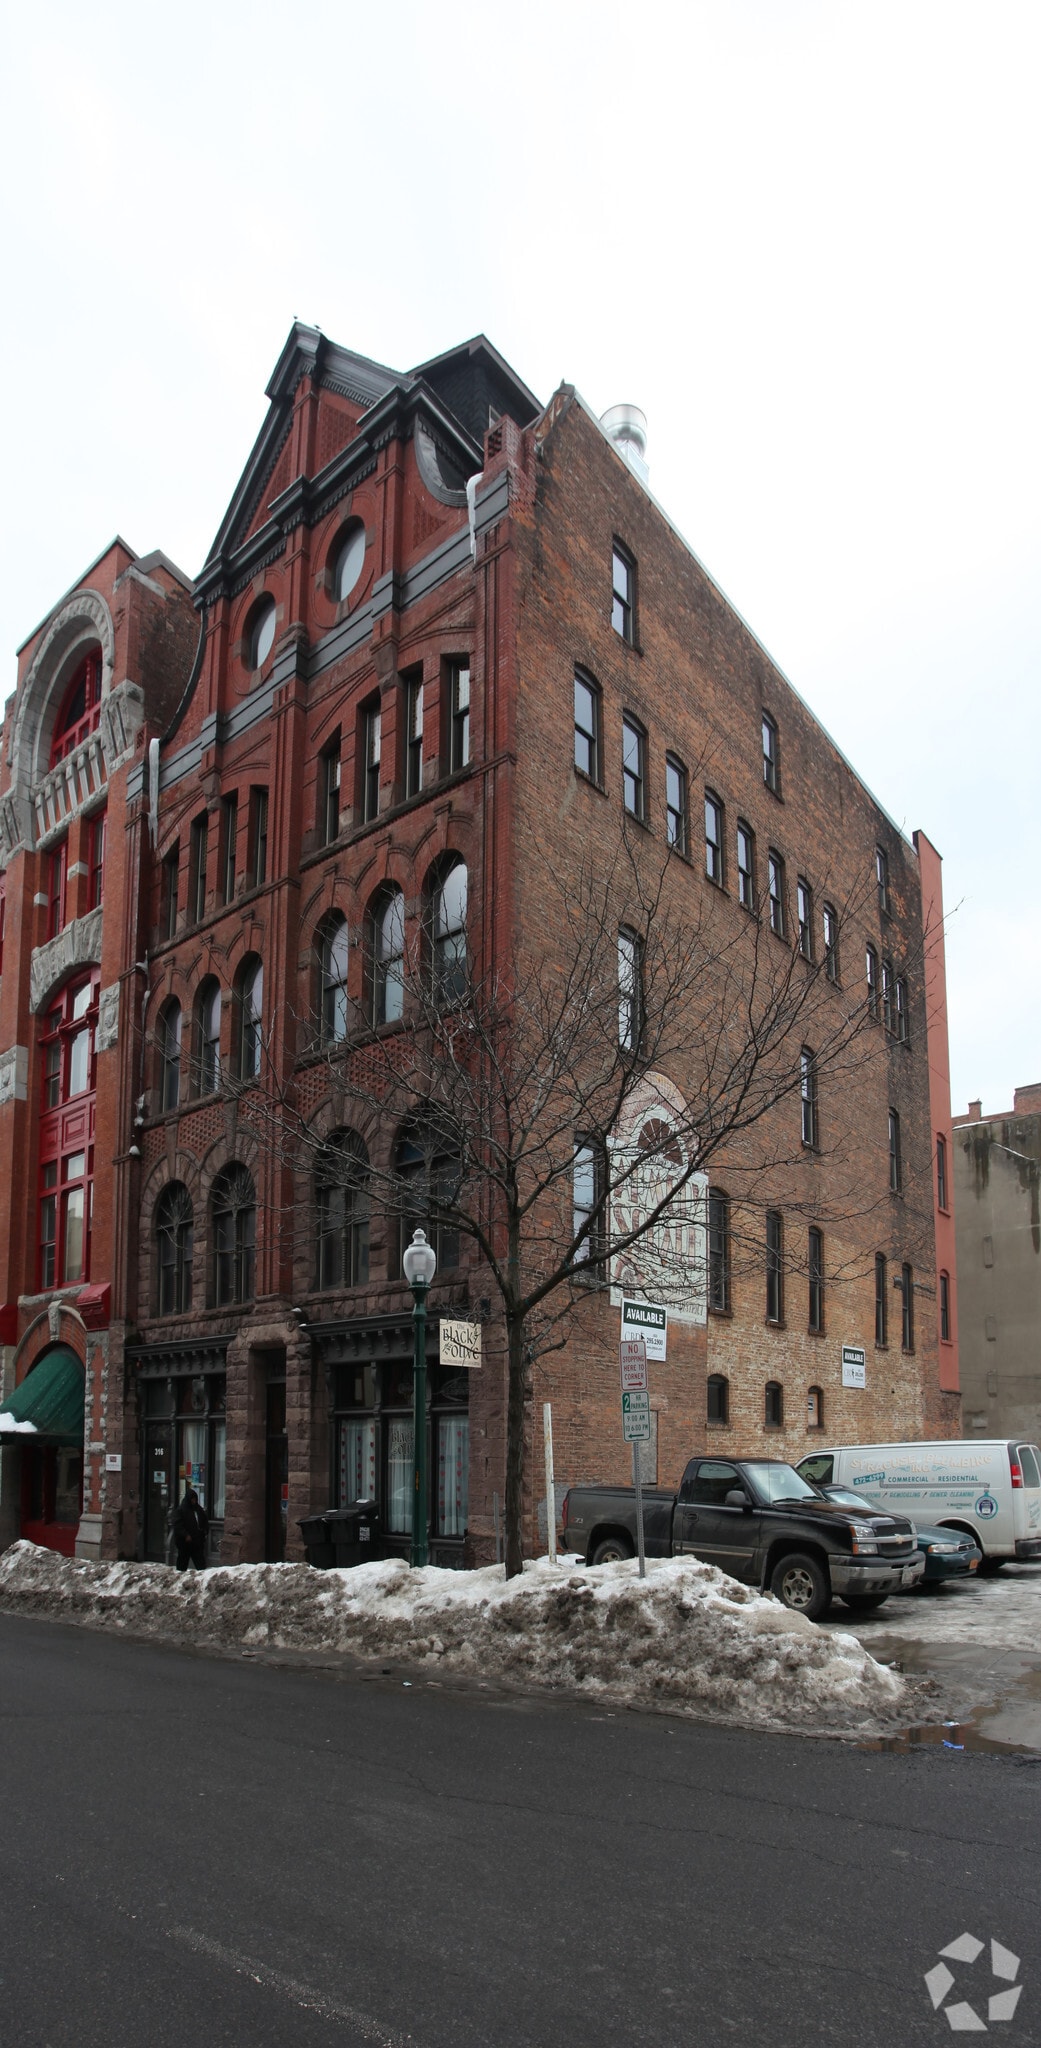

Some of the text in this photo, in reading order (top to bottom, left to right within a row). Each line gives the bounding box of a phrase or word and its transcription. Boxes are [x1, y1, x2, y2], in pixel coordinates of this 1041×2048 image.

[626, 1307, 664, 1325] AVAILABLE
[628, 1344, 639, 1354] NO
[624, 1372, 644, 1380] CORNER
[624, 1395, 630, 1411] 2
[850, 1453, 993, 1473] SYRACUSE PLUMBING
